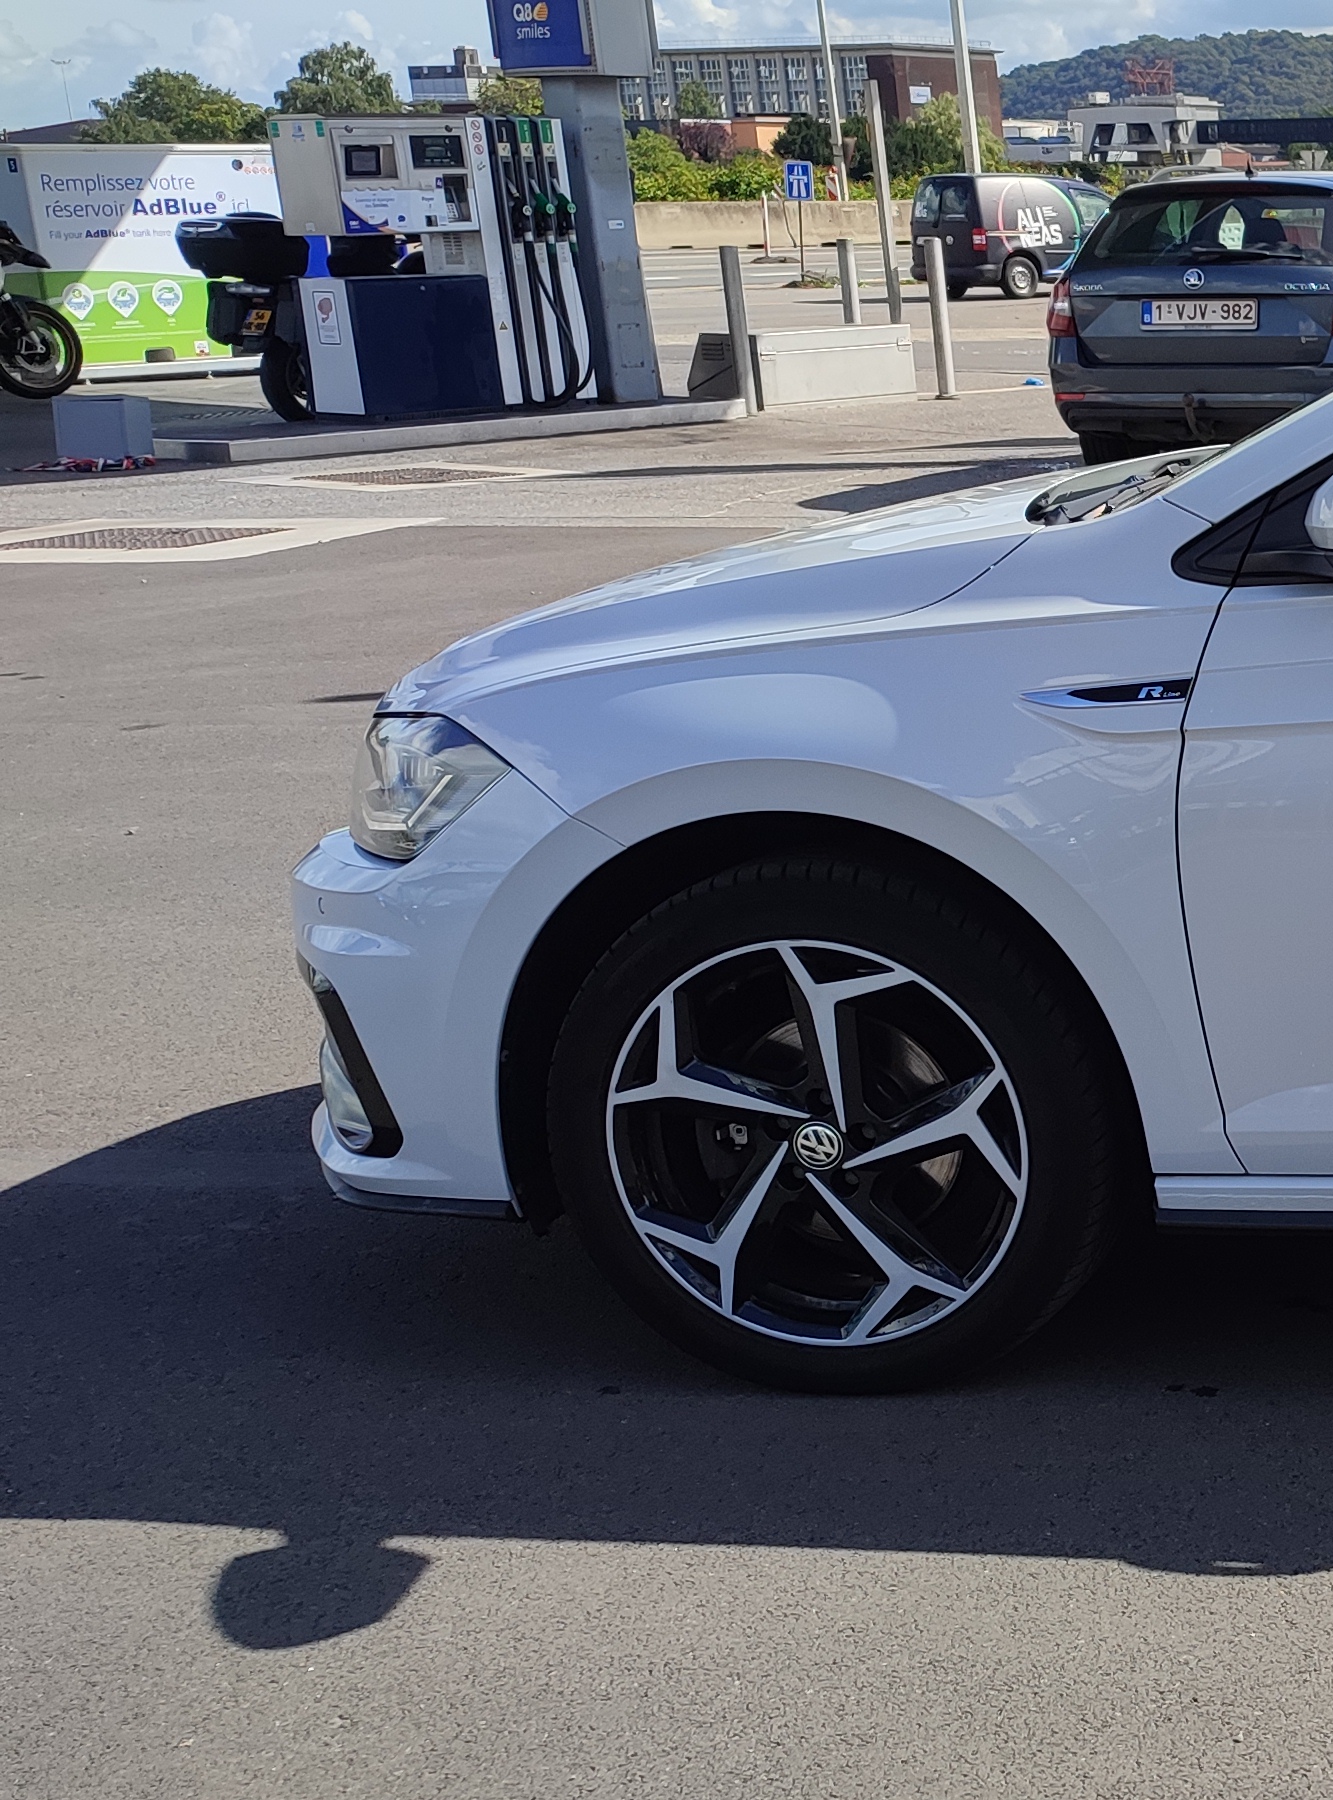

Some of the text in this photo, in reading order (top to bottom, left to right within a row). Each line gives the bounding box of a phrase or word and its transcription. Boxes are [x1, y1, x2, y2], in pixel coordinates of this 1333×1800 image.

[513, 3, 532, 21] Q8
[516, 23, 551, 39] smiles
[40, 174, 195, 196] Remplissez votre
[45, 200, 125, 218] réservoir
[63, 231, 83, 241] your
[1137, 686, 1163, 698] R
